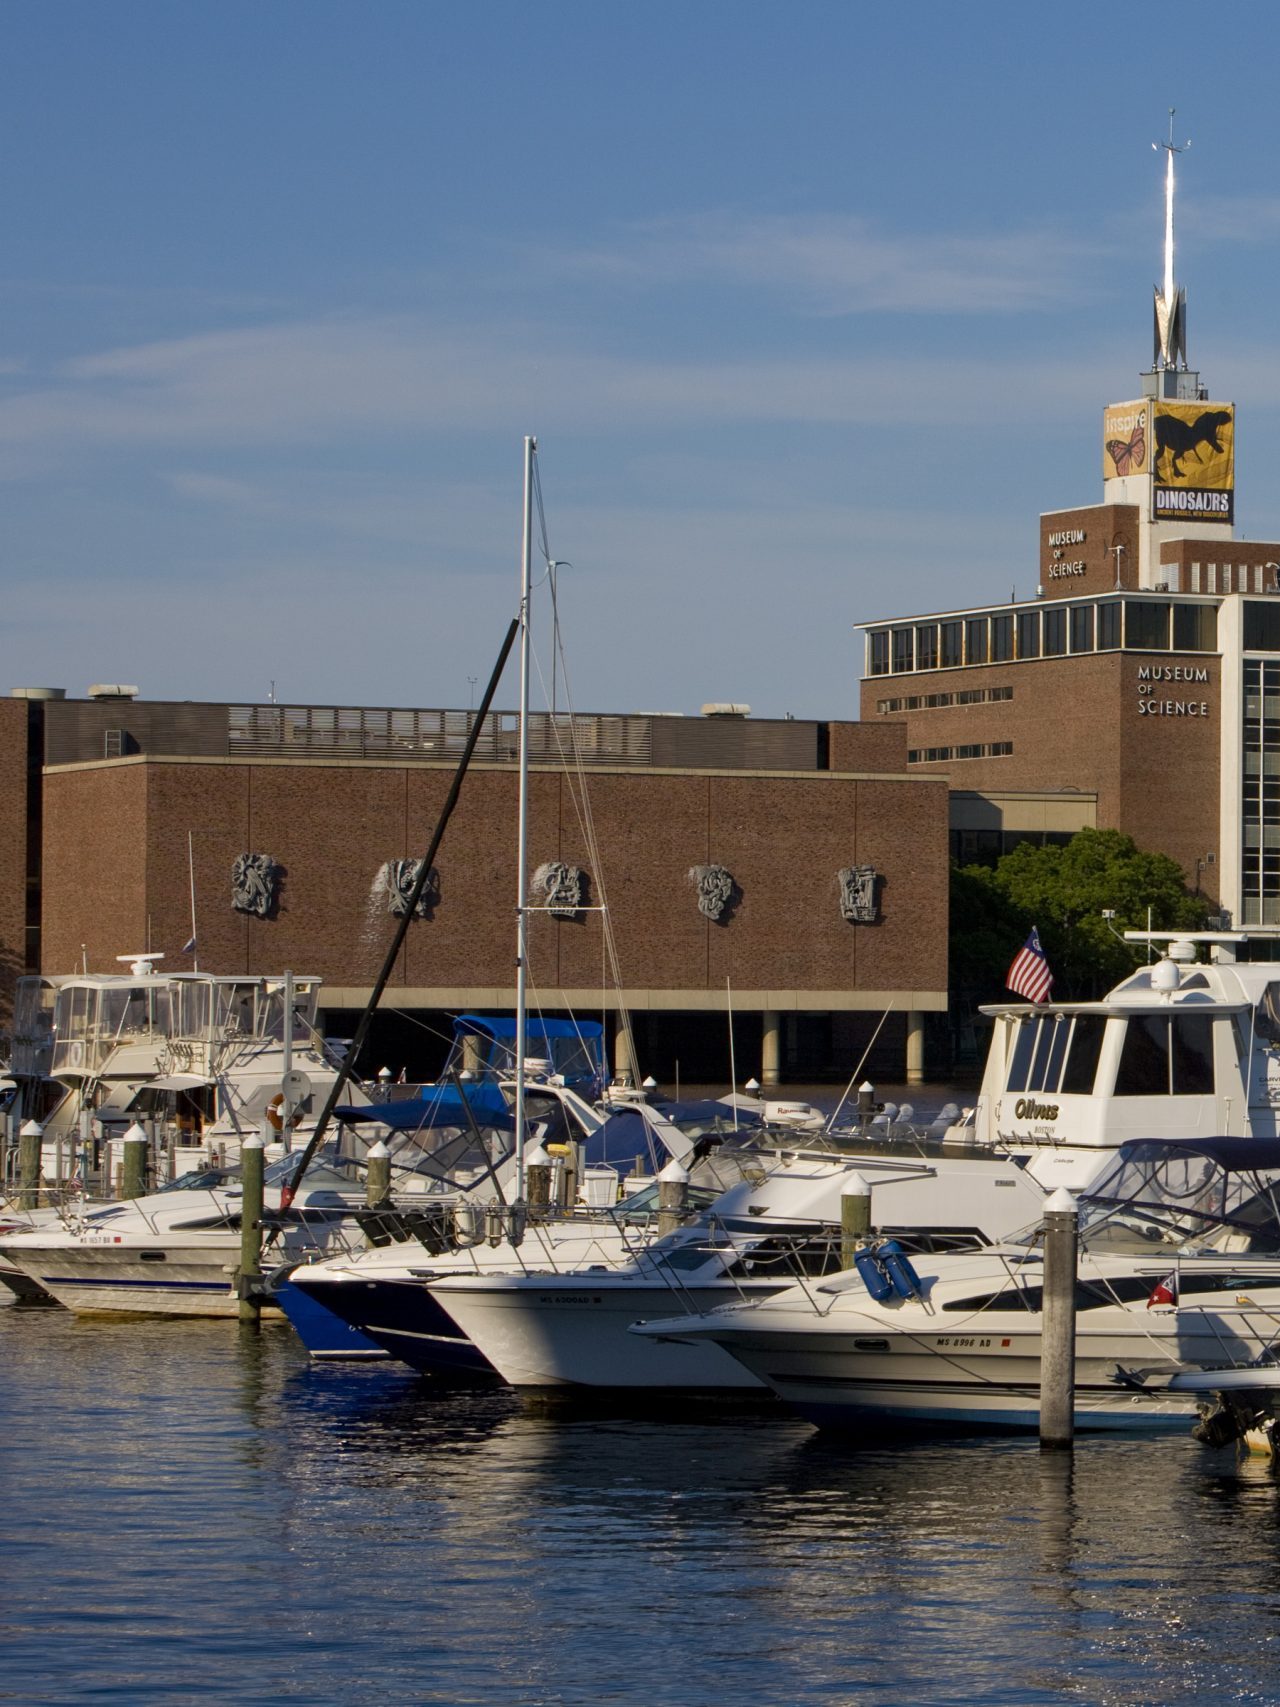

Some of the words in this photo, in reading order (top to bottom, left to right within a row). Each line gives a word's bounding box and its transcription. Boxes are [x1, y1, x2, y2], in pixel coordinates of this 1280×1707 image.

[1106, 412, 1146, 434] inspire
[1156, 490, 1229, 512] DINOSAURS
[1048, 529, 1084, 546] MUSEUM
[1048, 561, 1084, 578] SCIENCE
[1138, 665, 1207, 681] MUSEUM
[1138, 684, 1152, 694] OF
[1138, 700, 1207, 715] SCIENCE
[1015, 1098, 1060, 1120] Olivus
[1034, 1126, 1056, 1134] BOSTON
[936, 1338, 950, 1346] MS
[979, 1339, 992, 1348] AD
